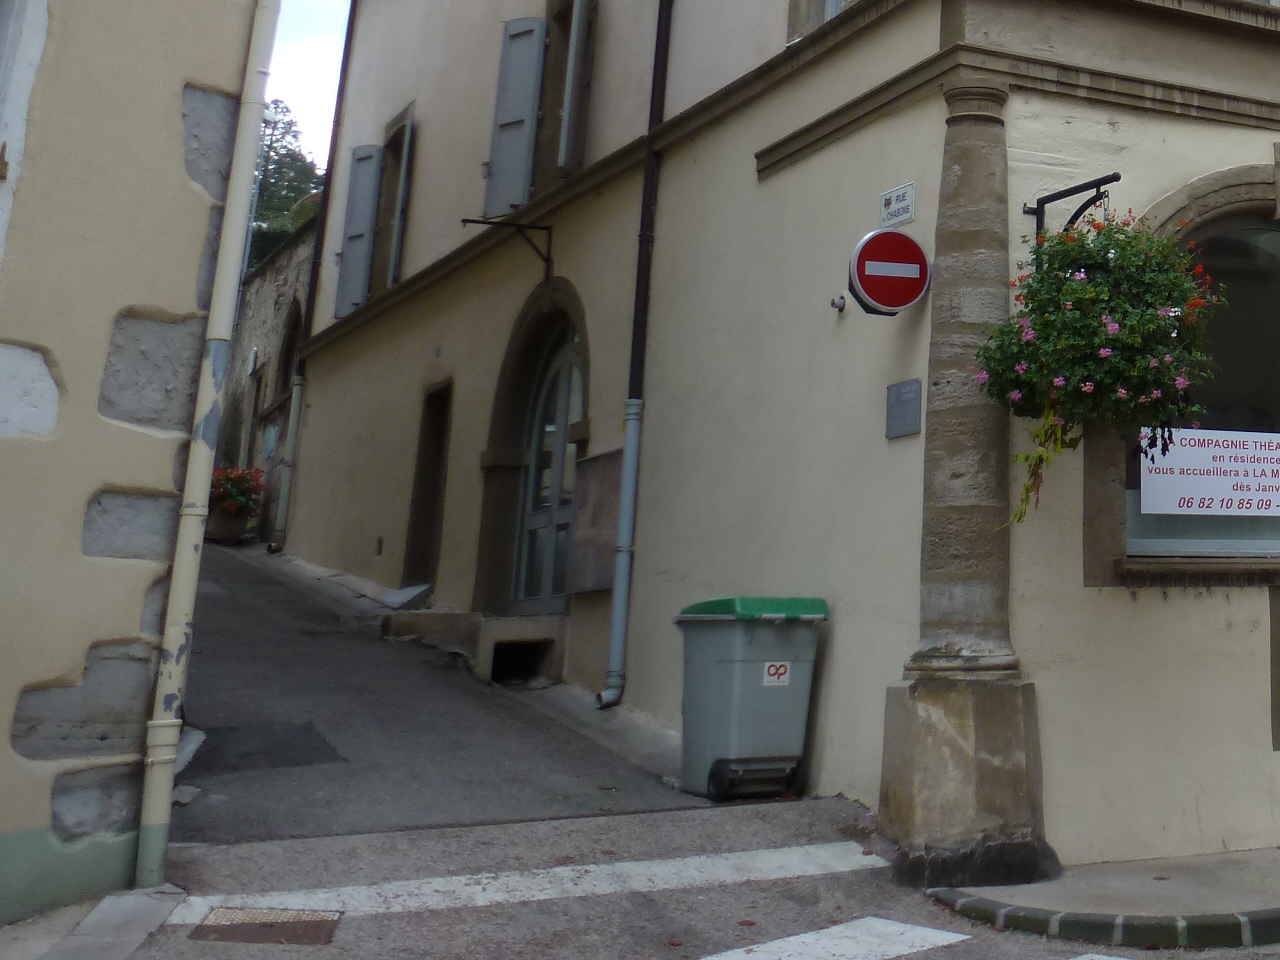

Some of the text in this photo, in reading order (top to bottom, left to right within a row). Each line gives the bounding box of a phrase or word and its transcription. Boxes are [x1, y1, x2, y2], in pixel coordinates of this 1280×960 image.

[895, 191, 907, 204] RUE
[1180, 437, 1249, 451] COMPAGNIE
[1212, 454, 1225, 463] en
[1147, 465, 1175, 476] vous
[1179, 466, 1240, 478] accueillera
[1243, 468, 1249, 477] à
[1252, 468, 1268, 478] LA
[1232, 482, 1252, 492] dès
[1178, 497, 1194, 509] 06
[1197, 497, 1214, 509] 82
[1219, 498, 1233, 510] 10
[1237, 498, 1253, 510] 85
[1256, 499, 1272, 510] 09
